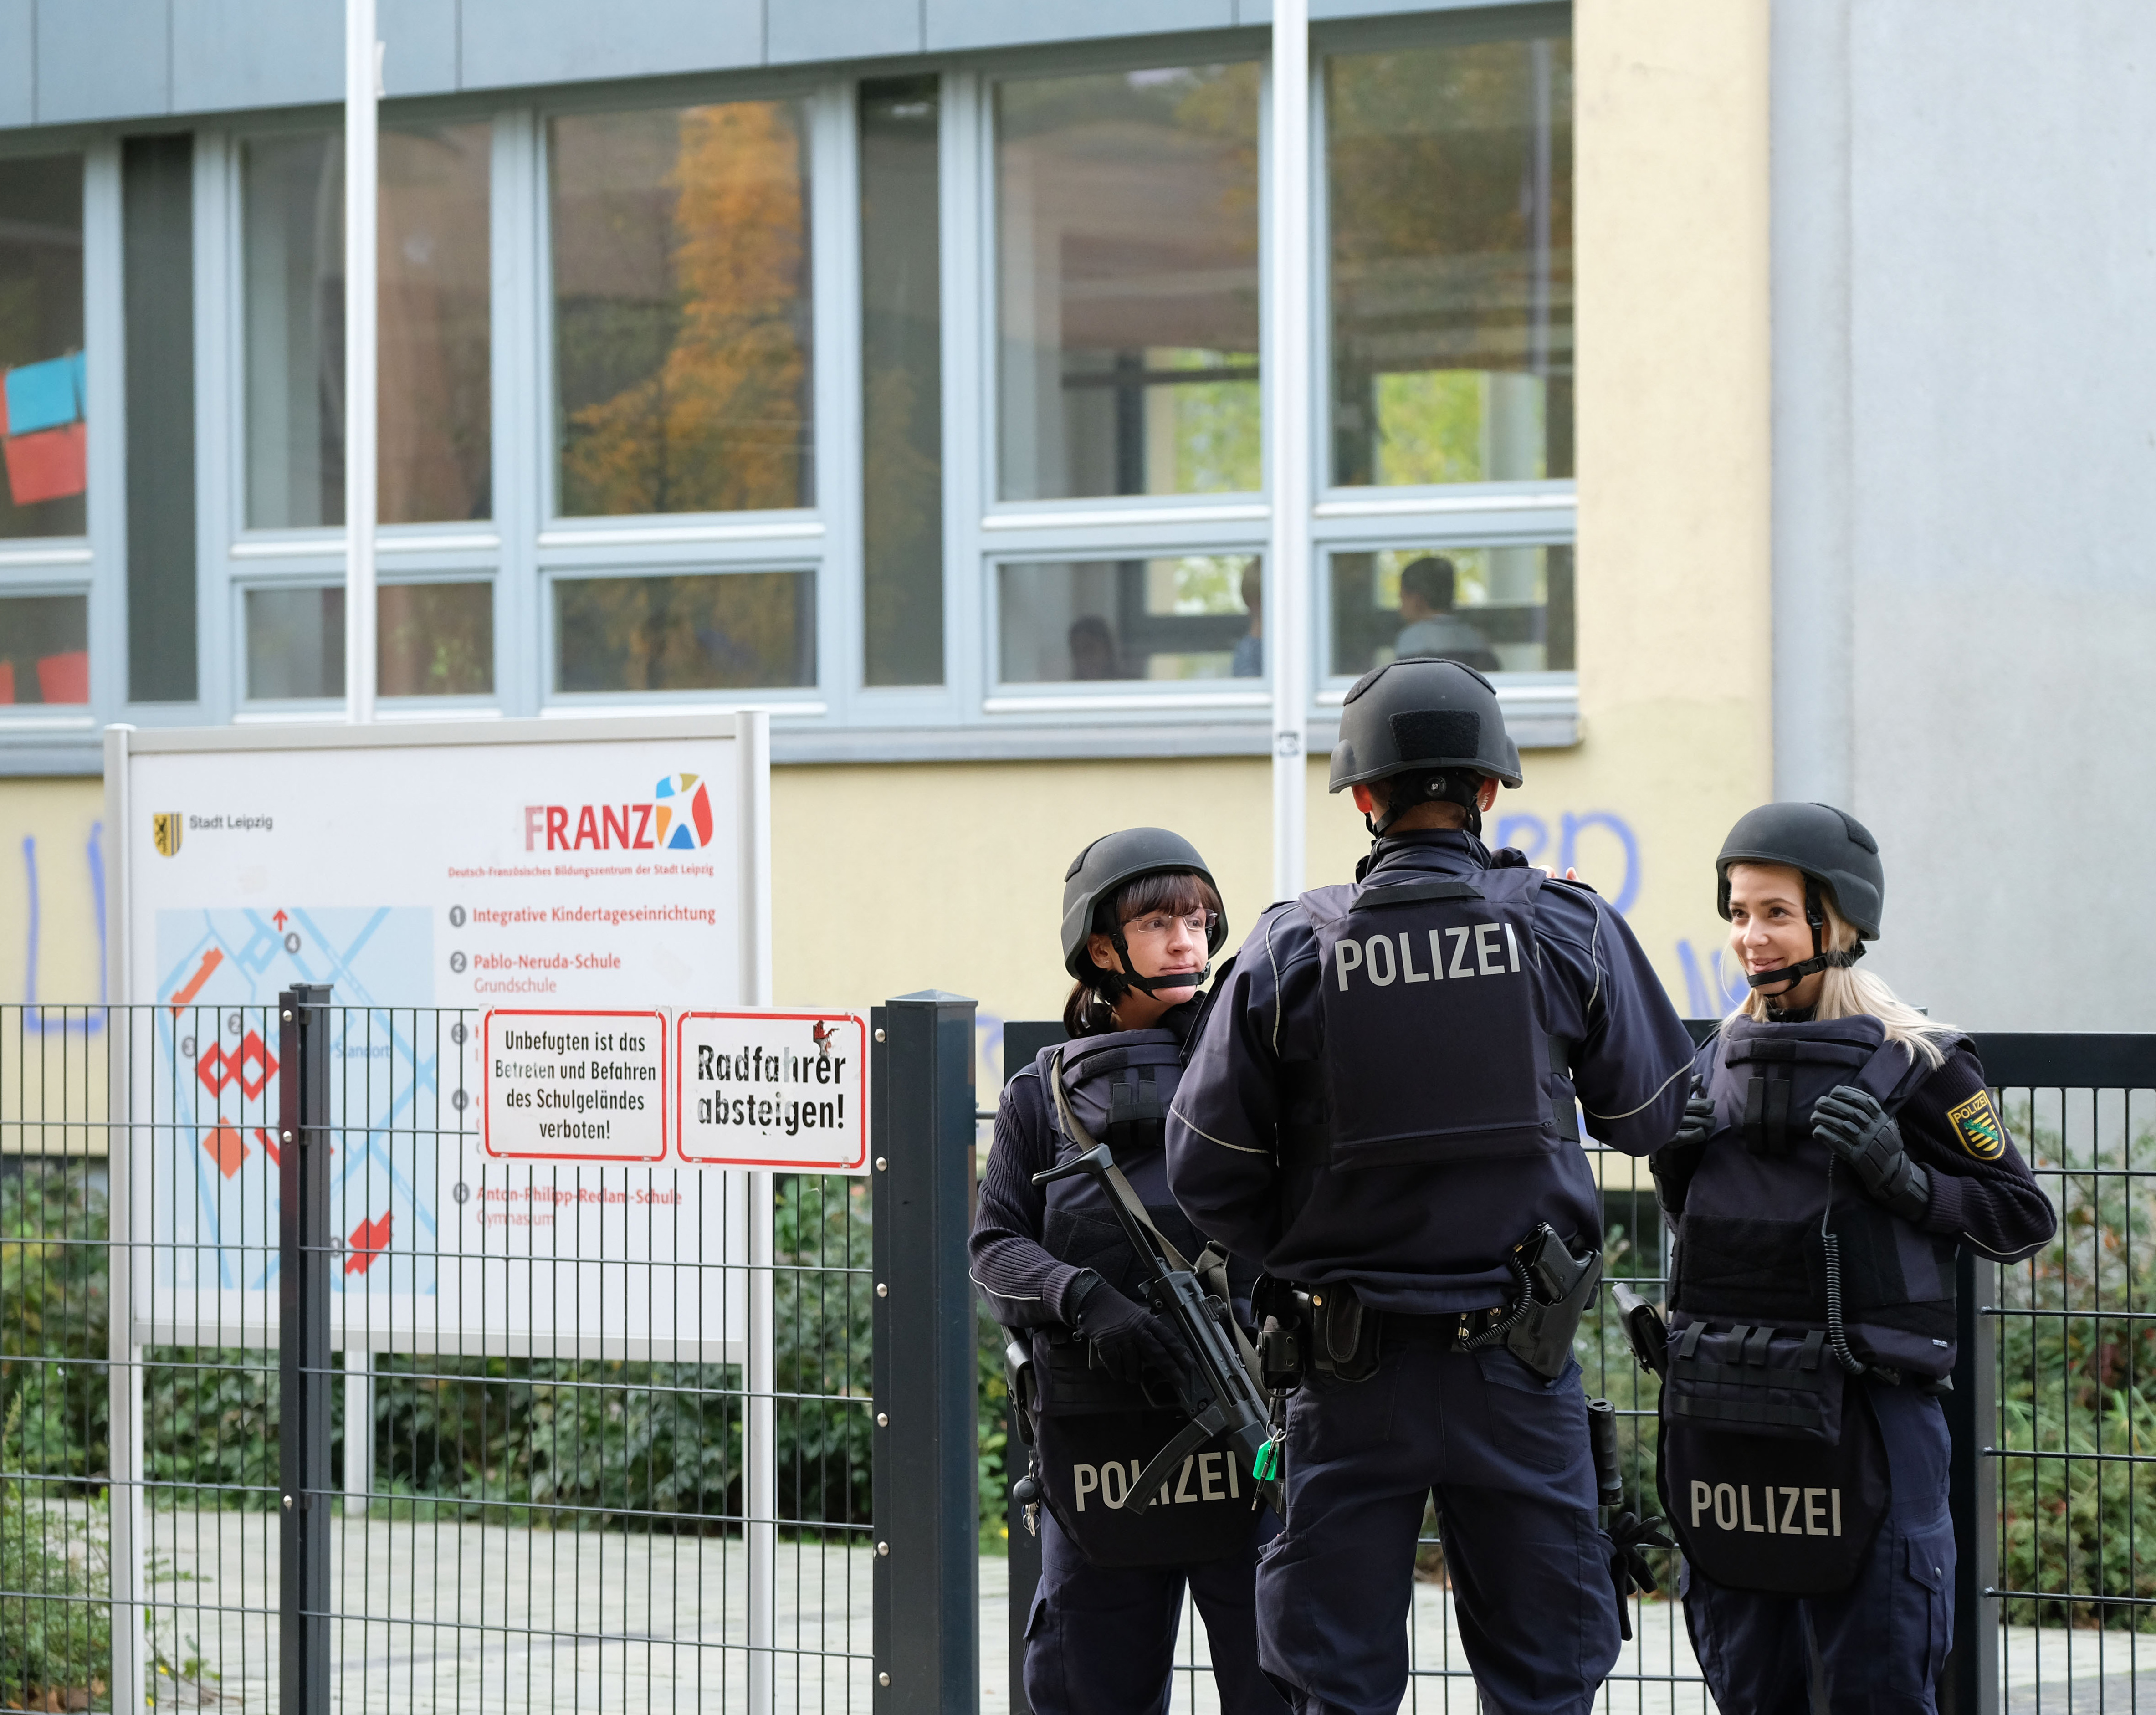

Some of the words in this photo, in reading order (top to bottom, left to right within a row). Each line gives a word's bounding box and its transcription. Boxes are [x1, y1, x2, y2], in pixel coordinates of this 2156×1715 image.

[189, 814, 223, 830] Stadt
[228, 814, 273, 832] Leipzig
[524, 803, 655, 851] FRANZ
[555, 864, 633, 878] Bildungszentrum
[636, 864, 650, 875] der
[654, 864, 678, 875] Stadt
[681, 863, 714, 877] Leipzig
[473, 906, 547, 926] Integrative
[552, 905, 716, 926] Kindertageseinrichtung
[474, 952, 621, 969] Pablo-Neruda-Schule
[1335, 922, 1521, 992] POLIZEI
[474, 976, 557, 993] Grundschule
[336, 1041, 390, 1059] Sandort
[506, 1030, 589, 1055] Unbefugten
[595, 1031, 614, 1051] ist
[620, 1032, 645, 1052] das
[496, 1059, 555, 1079] Betreten
[560, 1061, 585, 1080] und
[592, 1061, 656, 1081] Befahren
[698, 1044, 846, 1084] Radfahrer
[507, 1088, 532, 1108] des
[537, 1088, 645, 1114] Schulgeländes
[1953, 1095, 1988, 1124] POLIZEI
[697, 1090, 844, 1136] absteigen!
[539, 1119, 610, 1139] verboten!
[477, 1208, 555, 1229] Gymnasum
[1690, 1480, 1841, 1536] POLIZEI
